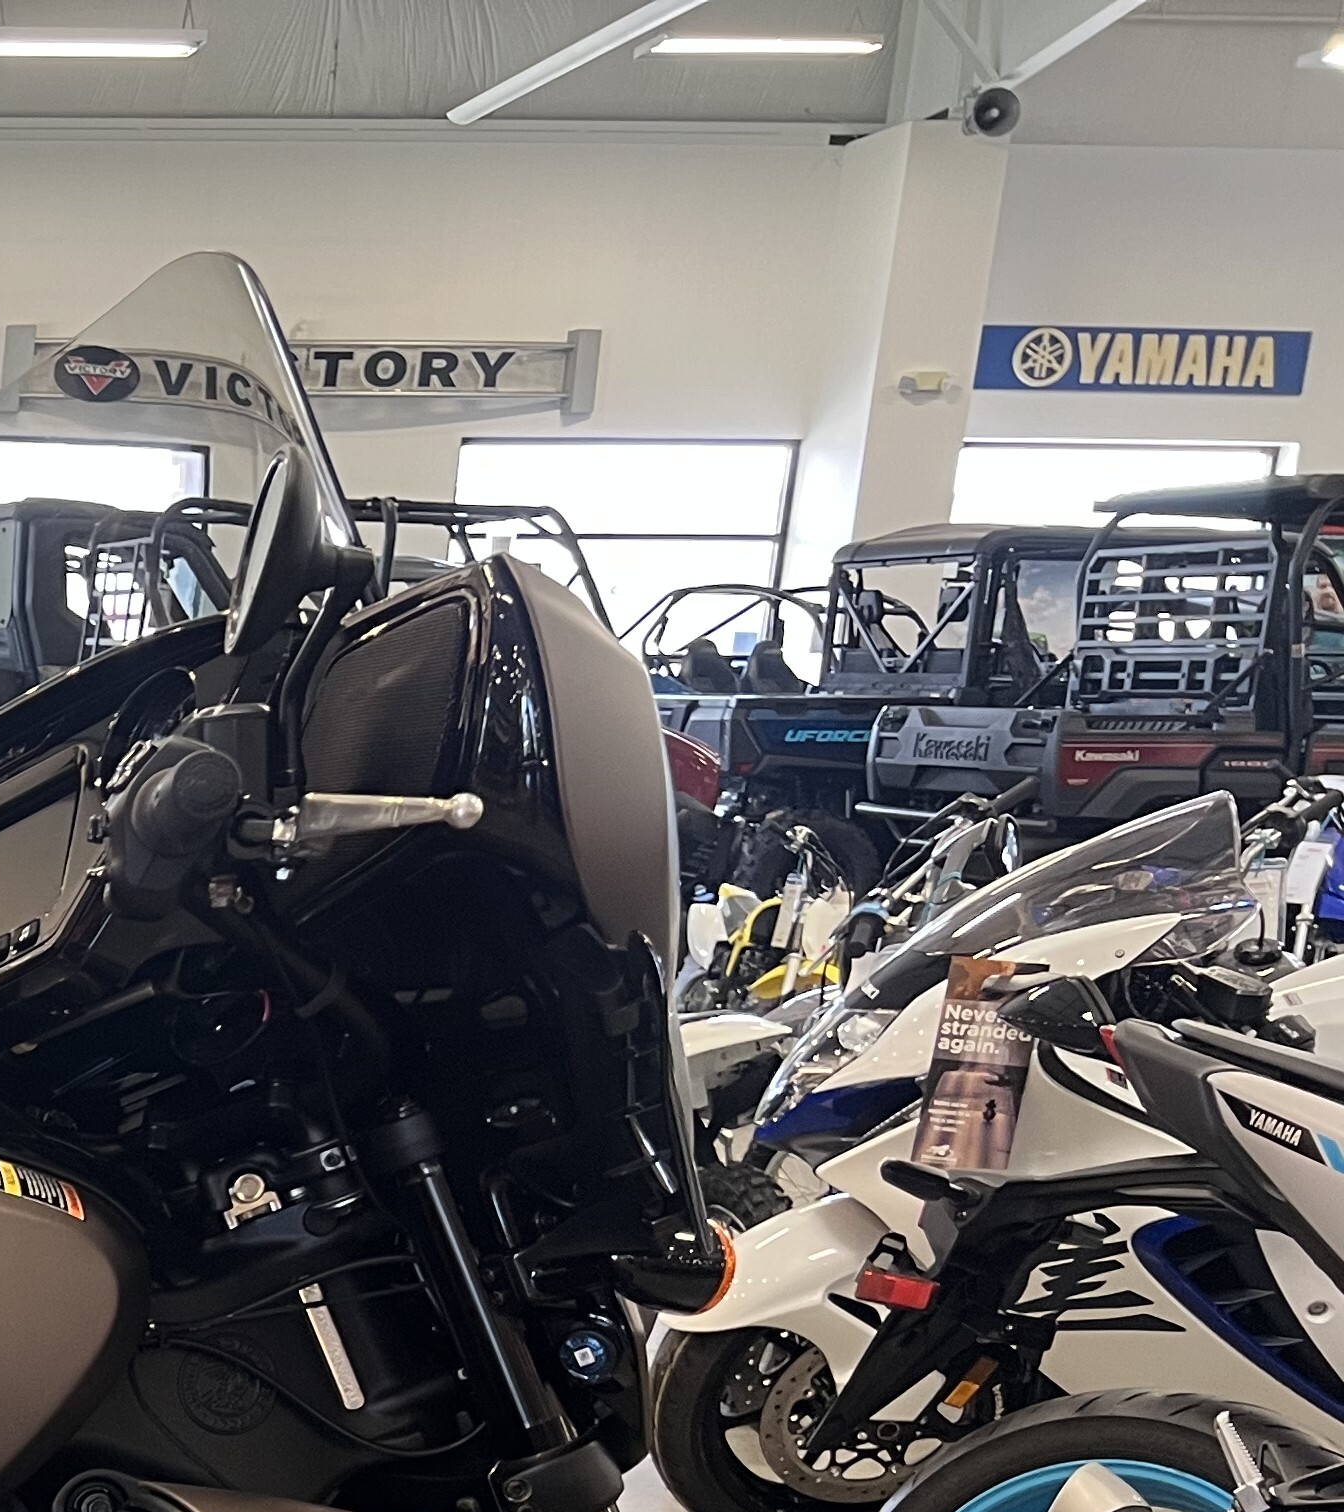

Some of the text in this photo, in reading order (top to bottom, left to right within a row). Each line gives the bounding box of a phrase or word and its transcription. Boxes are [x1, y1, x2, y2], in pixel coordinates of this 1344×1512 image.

[1077, 332, 1275, 388] YAMAHA
[783, 729, 870, 743] UFORC
[912, 732, 992, 762] Kawasaki
[1074, 749, 1140, 763] Kawasaki
[944, 1003, 1002, 1024] Neve
[937, 1037, 1001, 1055] again.
[1248, 1108, 1303, 1147] YAMAHA
